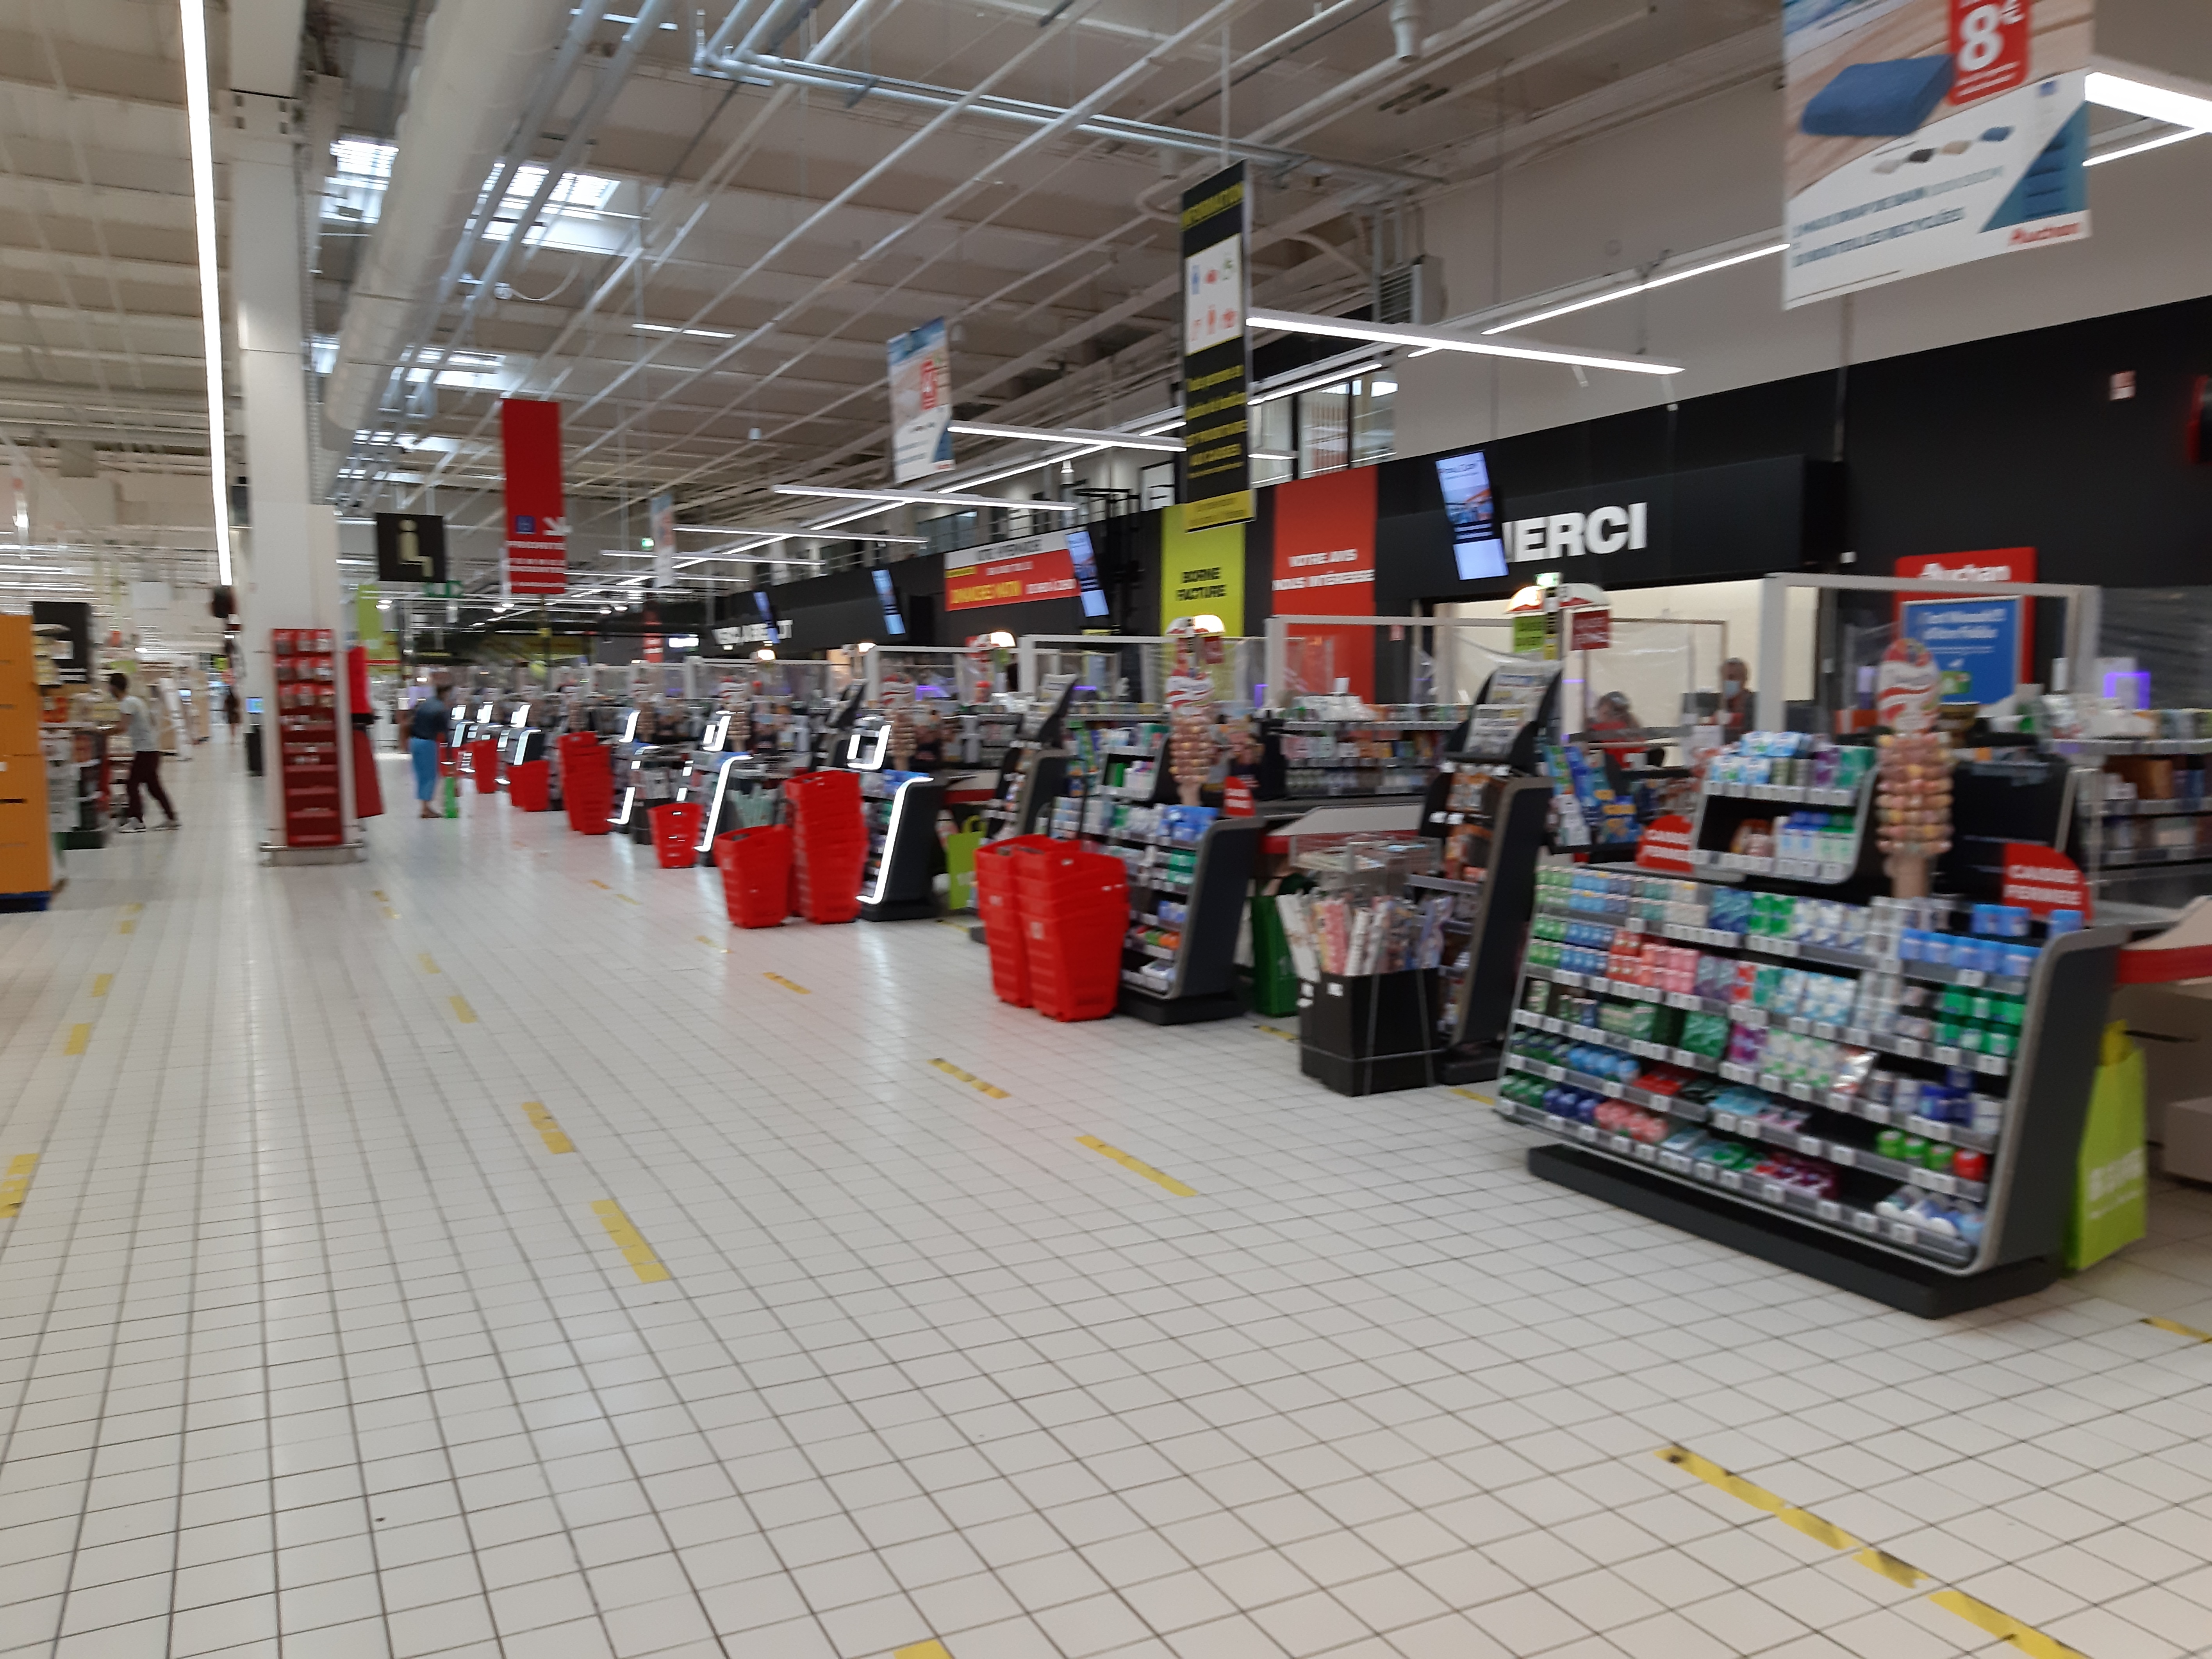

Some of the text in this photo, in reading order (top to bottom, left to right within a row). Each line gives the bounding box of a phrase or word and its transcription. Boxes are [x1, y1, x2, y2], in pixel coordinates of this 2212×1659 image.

[1502, 502, 1648, 563] ERCI
[1288, 549, 1358, 567] VOTRE AVIS
[1182, 567, 1221, 583] BORNE
[1176, 584, 1227, 601] FACTURE
[1272, 577, 1306, 591] NOUS
